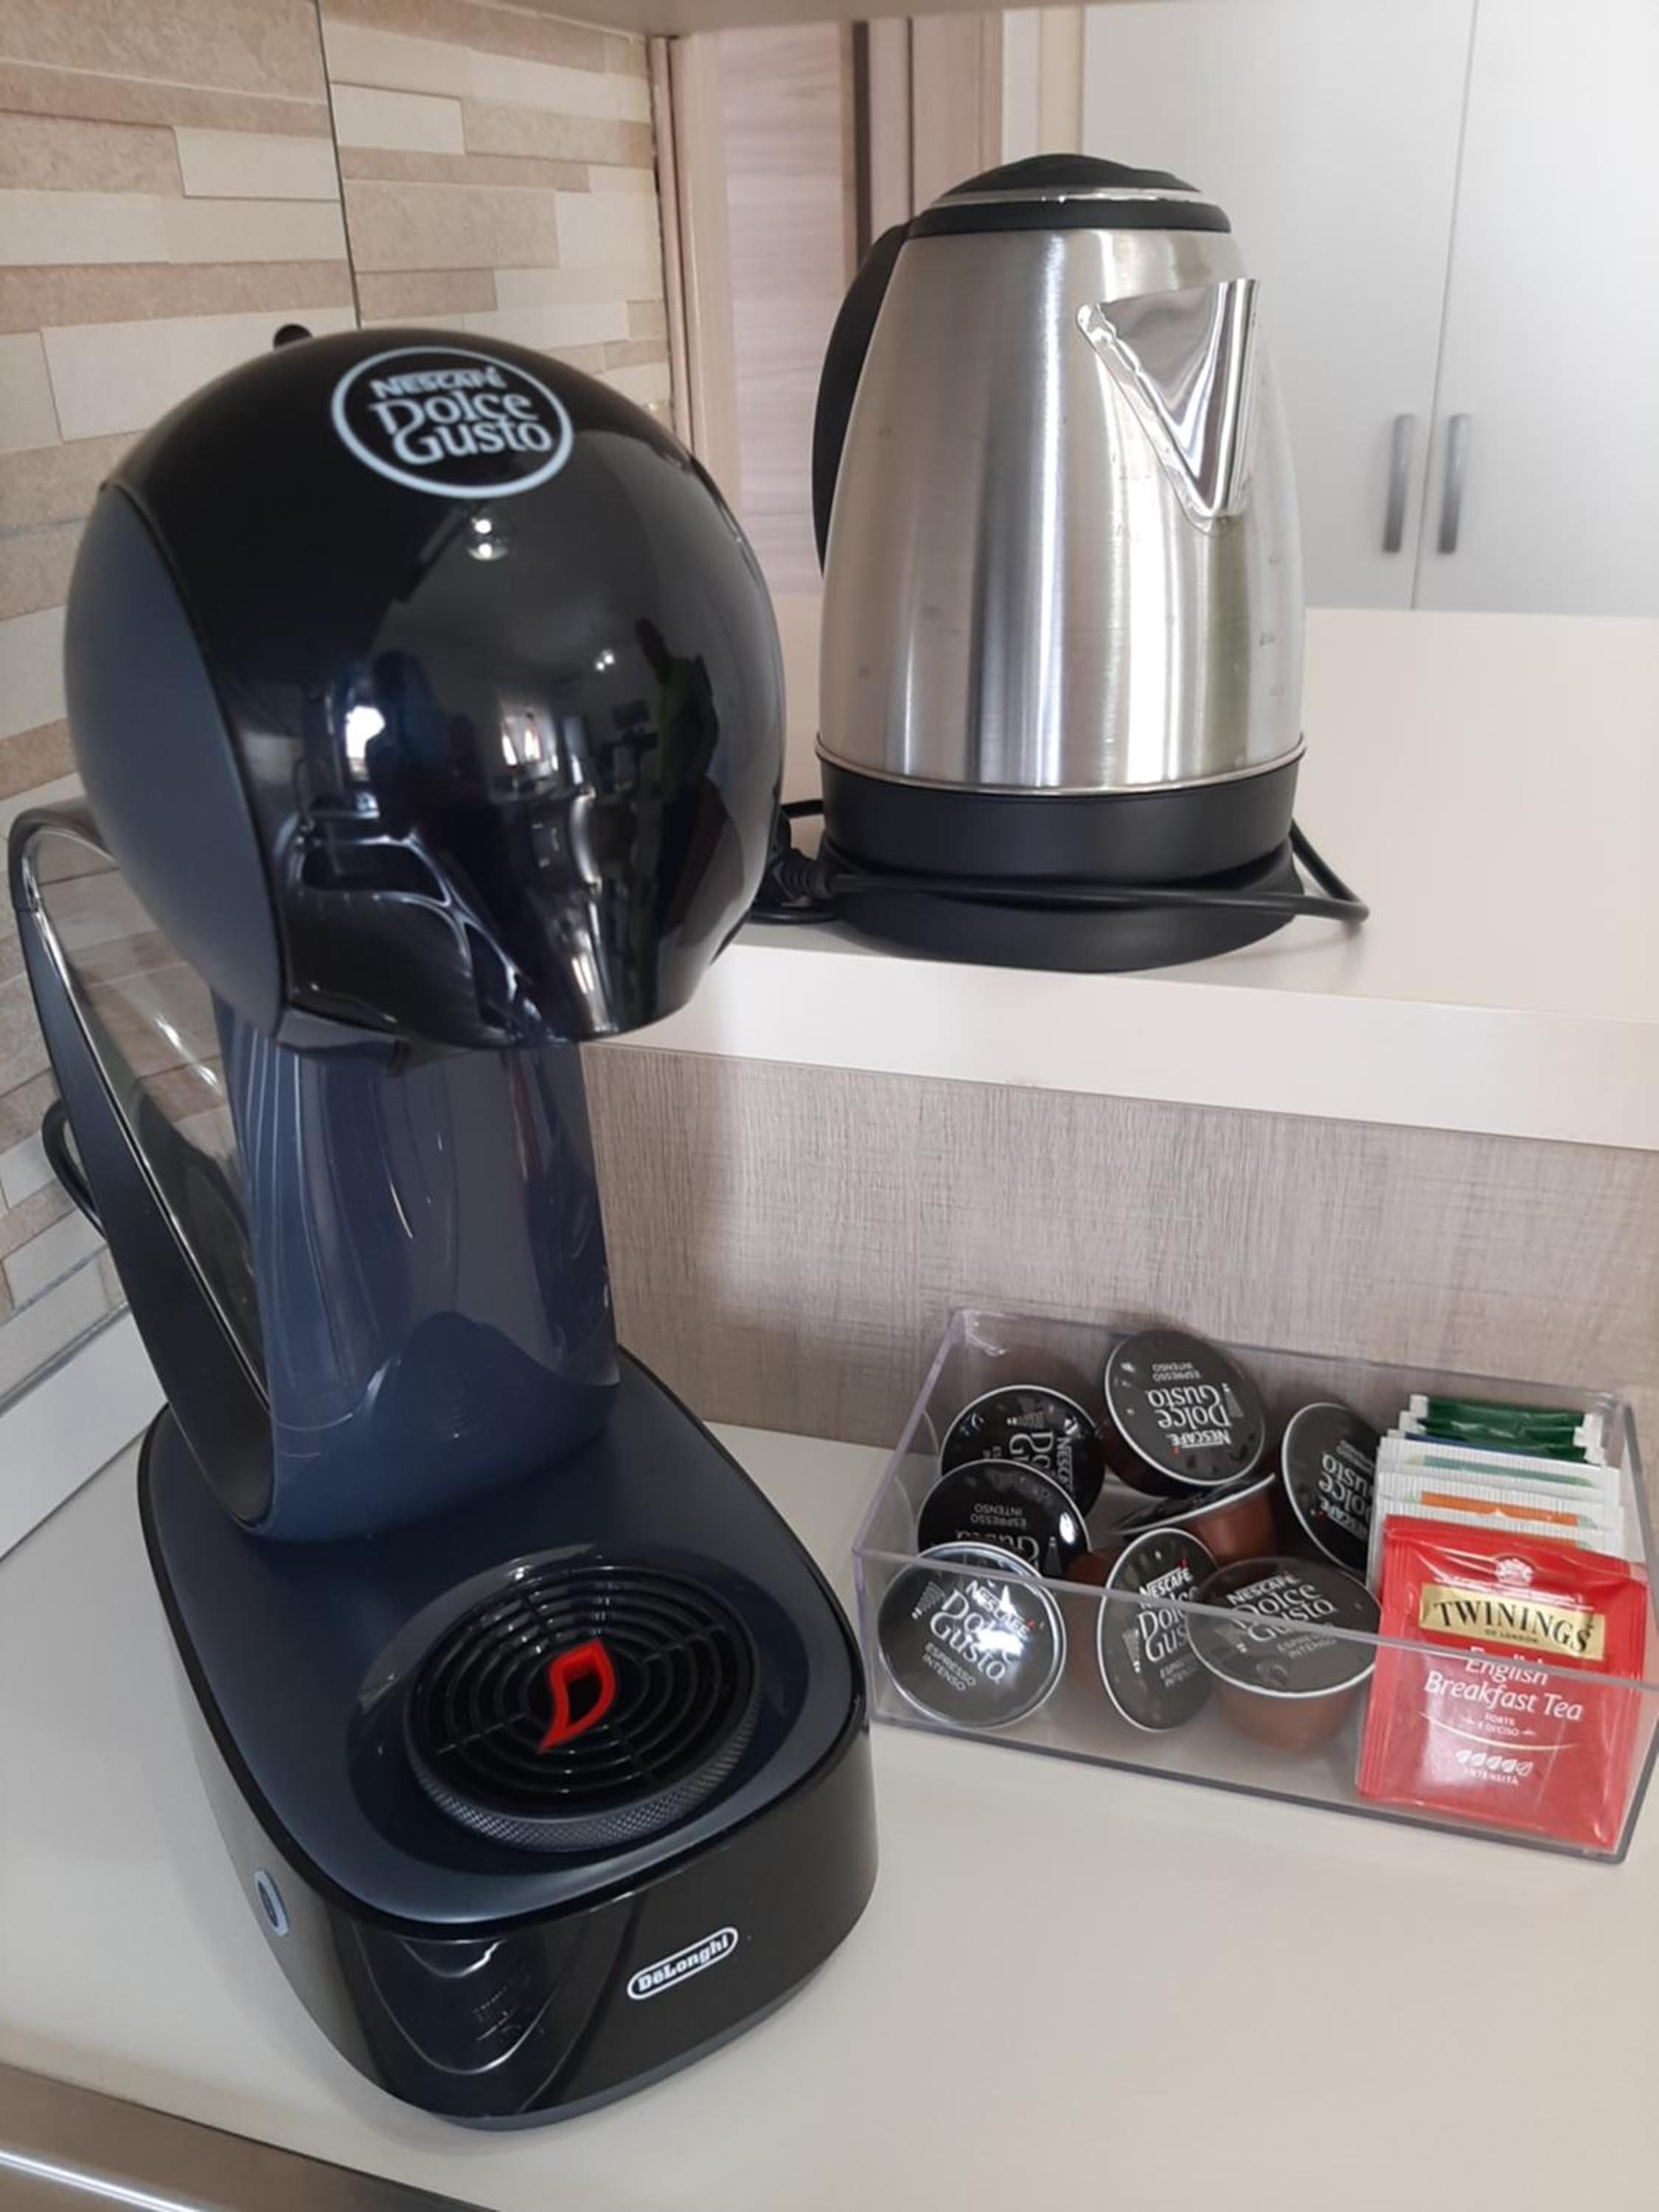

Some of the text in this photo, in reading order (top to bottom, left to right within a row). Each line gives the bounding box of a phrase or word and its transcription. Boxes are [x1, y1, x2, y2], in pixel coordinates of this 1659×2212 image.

[370, 391, 540, 435] Dolce
[394, 417, 552, 465] Gusto
[1144, 1384, 1220, 1408] Gusto
[1154, 1404, 1232, 1430] Dolce
[1318, 1471, 1370, 1520] olce
[1323, 1452, 1374, 1499] usto
[1433, 1600, 1594, 1653] TWININGS
[1424, 1669, 1584, 1721] Breakfast Tea
